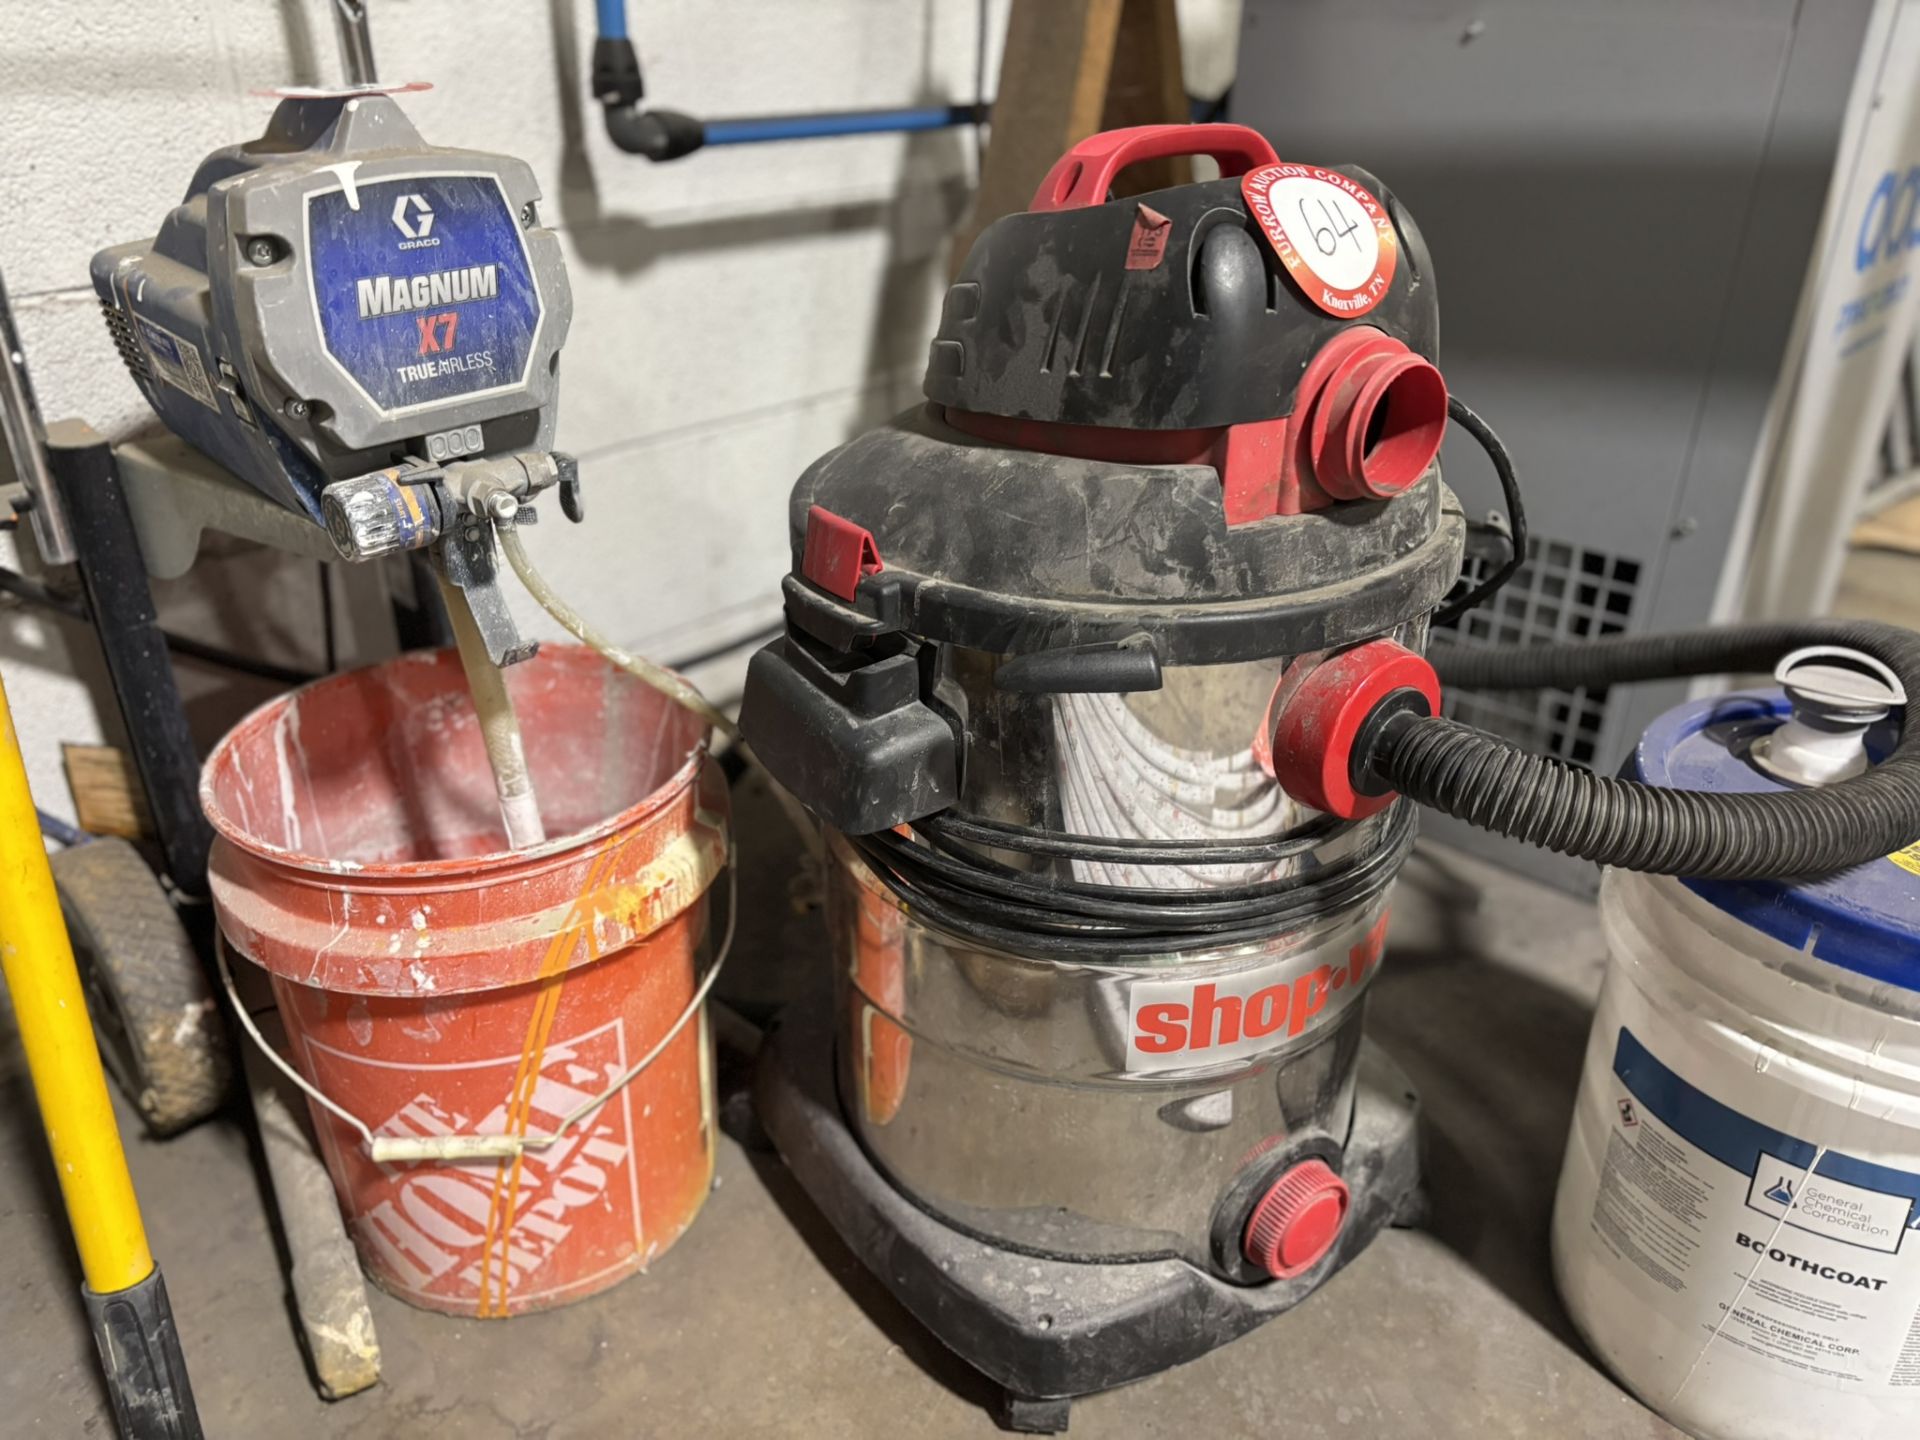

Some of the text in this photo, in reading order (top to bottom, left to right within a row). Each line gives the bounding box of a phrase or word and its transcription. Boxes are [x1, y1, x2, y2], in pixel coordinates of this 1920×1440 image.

[1249, 166, 1309, 192] AUCTION
[1314, 169, 1395, 245] COMPANY
[398, 237, 441, 251] GRACO
[1299, 198, 1363, 257] 64
[357, 264, 499, 319] MAGNUM
[1322, 274, 1386, 311] Knoxville, TN
[416, 312, 459, 356] X7
[353, 1048, 626, 1291] HOME
[458, 1124, 628, 1298] DEPOT
[1804, 1196, 1873, 1224] Chemical
[1806, 1187, 1864, 1212] General
[1802, 1205, 1890, 1237] Corporation
[1769, 1324, 1826, 1349] CHEMICAL
[1828, 1343, 1861, 1356] CORP.
